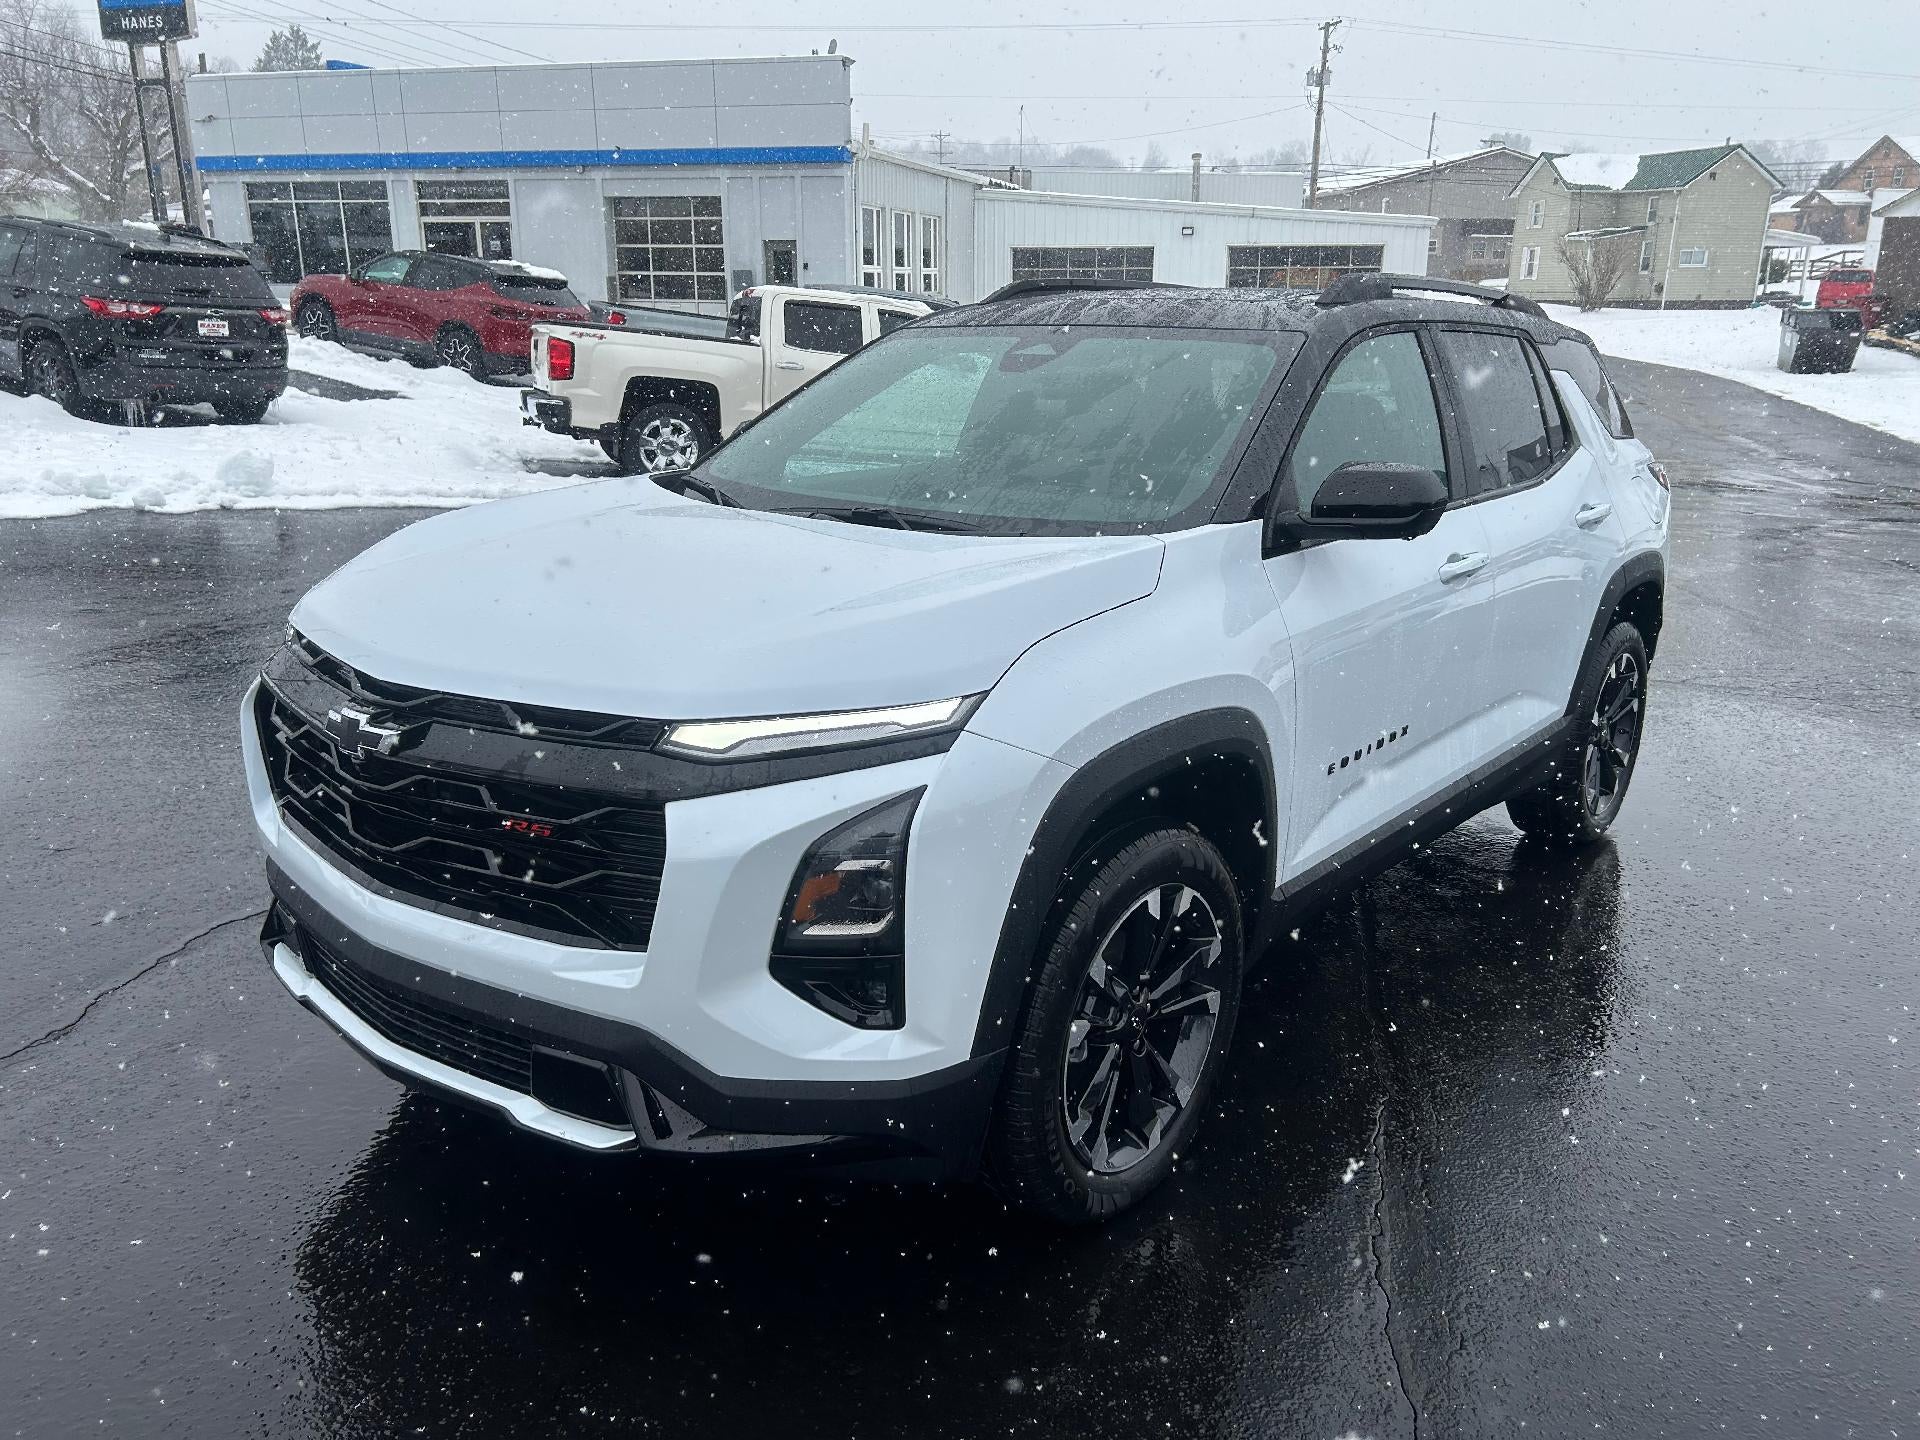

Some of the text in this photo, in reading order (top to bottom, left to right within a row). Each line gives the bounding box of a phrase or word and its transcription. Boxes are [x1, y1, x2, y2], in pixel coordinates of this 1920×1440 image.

[121, 15, 163, 29] HANES
[1327, 725, 1409, 775] EQUINOX
[504, 818, 553, 837] RS
